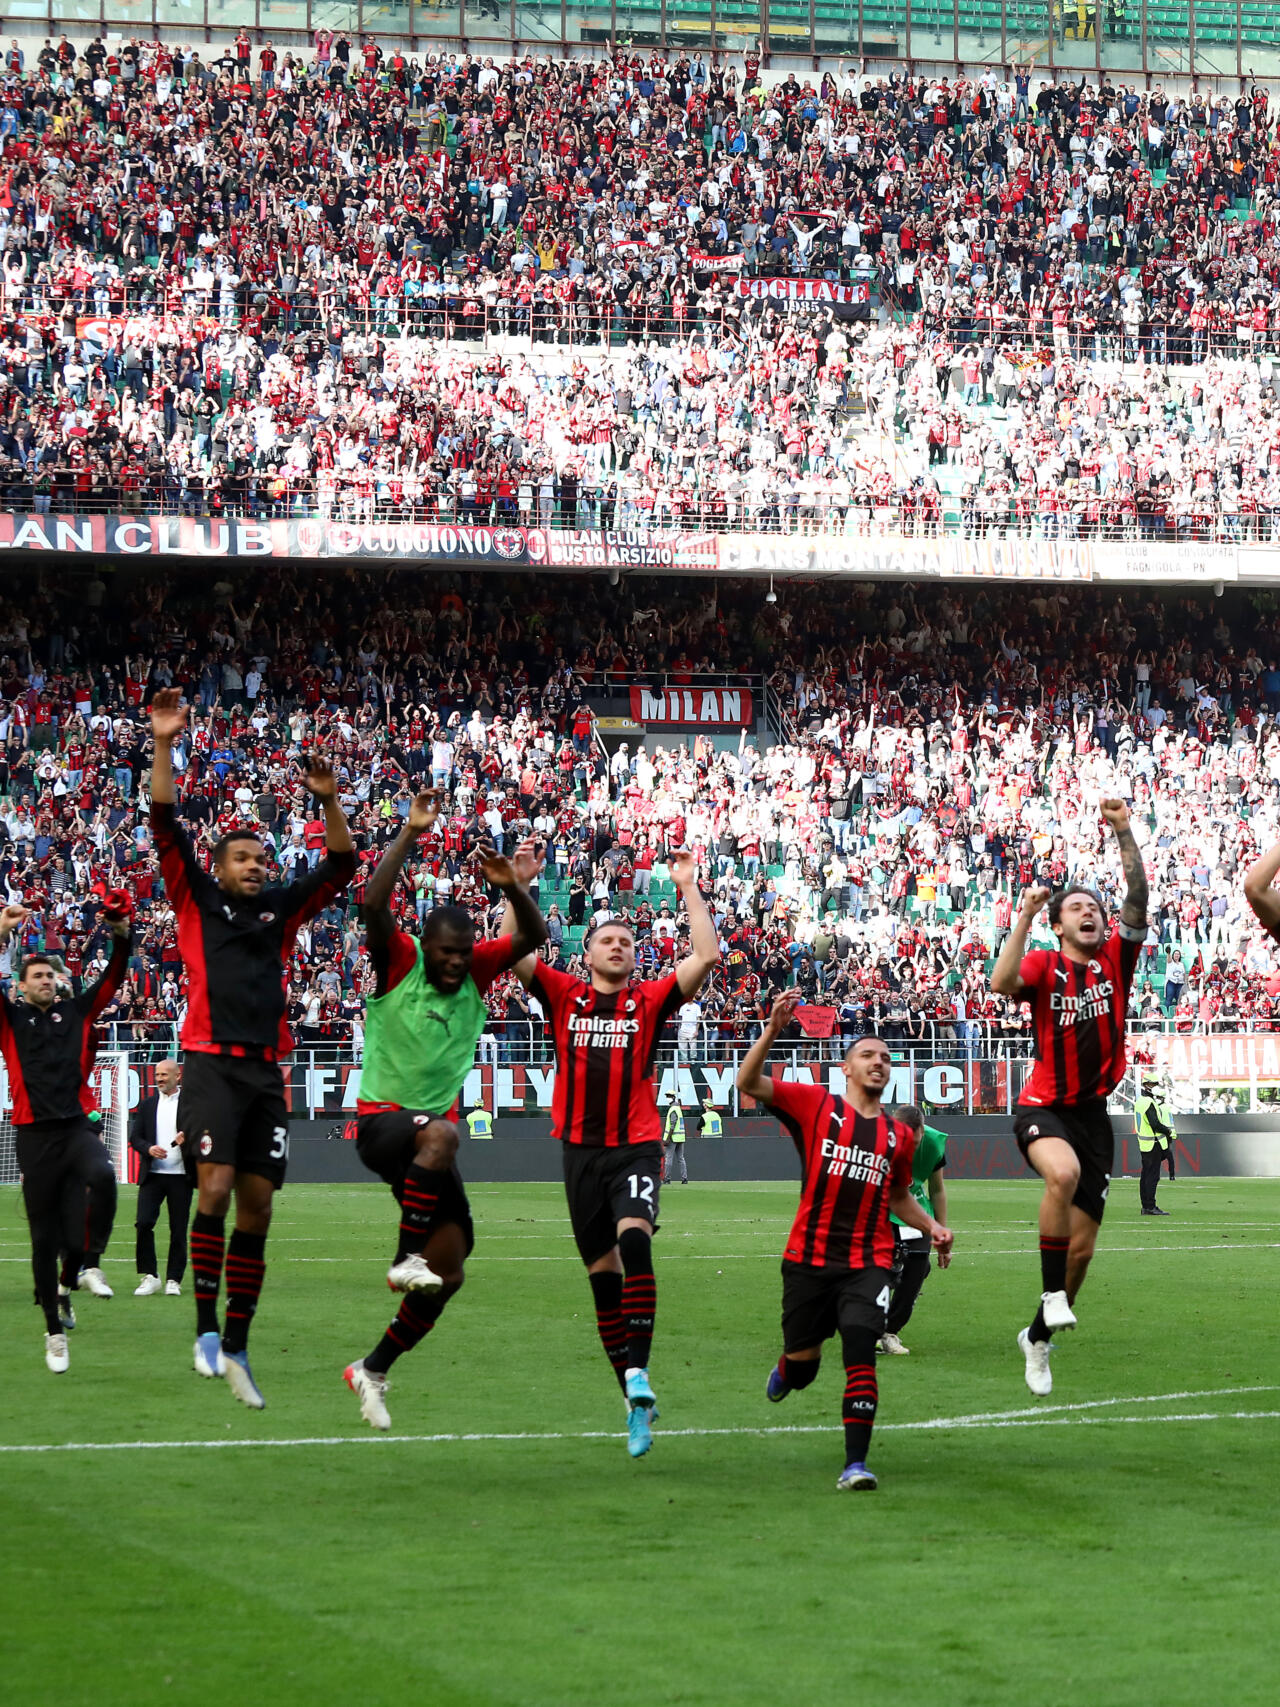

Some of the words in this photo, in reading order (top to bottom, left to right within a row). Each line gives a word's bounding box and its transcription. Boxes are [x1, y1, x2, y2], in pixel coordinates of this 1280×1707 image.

[736, 280, 866, 303] COGLIATE
[783, 301, 820, 312] 1985
[114, 522, 274, 555] CLUB
[363, 527, 491, 554] CUGGIONO
[551, 530, 602, 545] MILAN
[606, 531, 648, 546] CLUB
[551, 545, 605, 563] BUSTO
[608, 547, 671, 564] ARSIZIO
[816, 546, 940, 571] MONTANA
[640, 689, 741, 722] MILAN
[568, 1013, 640, 1032] Emirates
[573, 1033, 590, 1047] FLY
[591, 1033, 629, 1048] BETTER
[827, 1160, 848, 1176] FLY
[848, 1164, 883, 1186] BETTER
[627, 1174, 655, 1203] 12
[876, 1285, 891, 1314] 4
[852, 1400, 874, 1410] ACM
